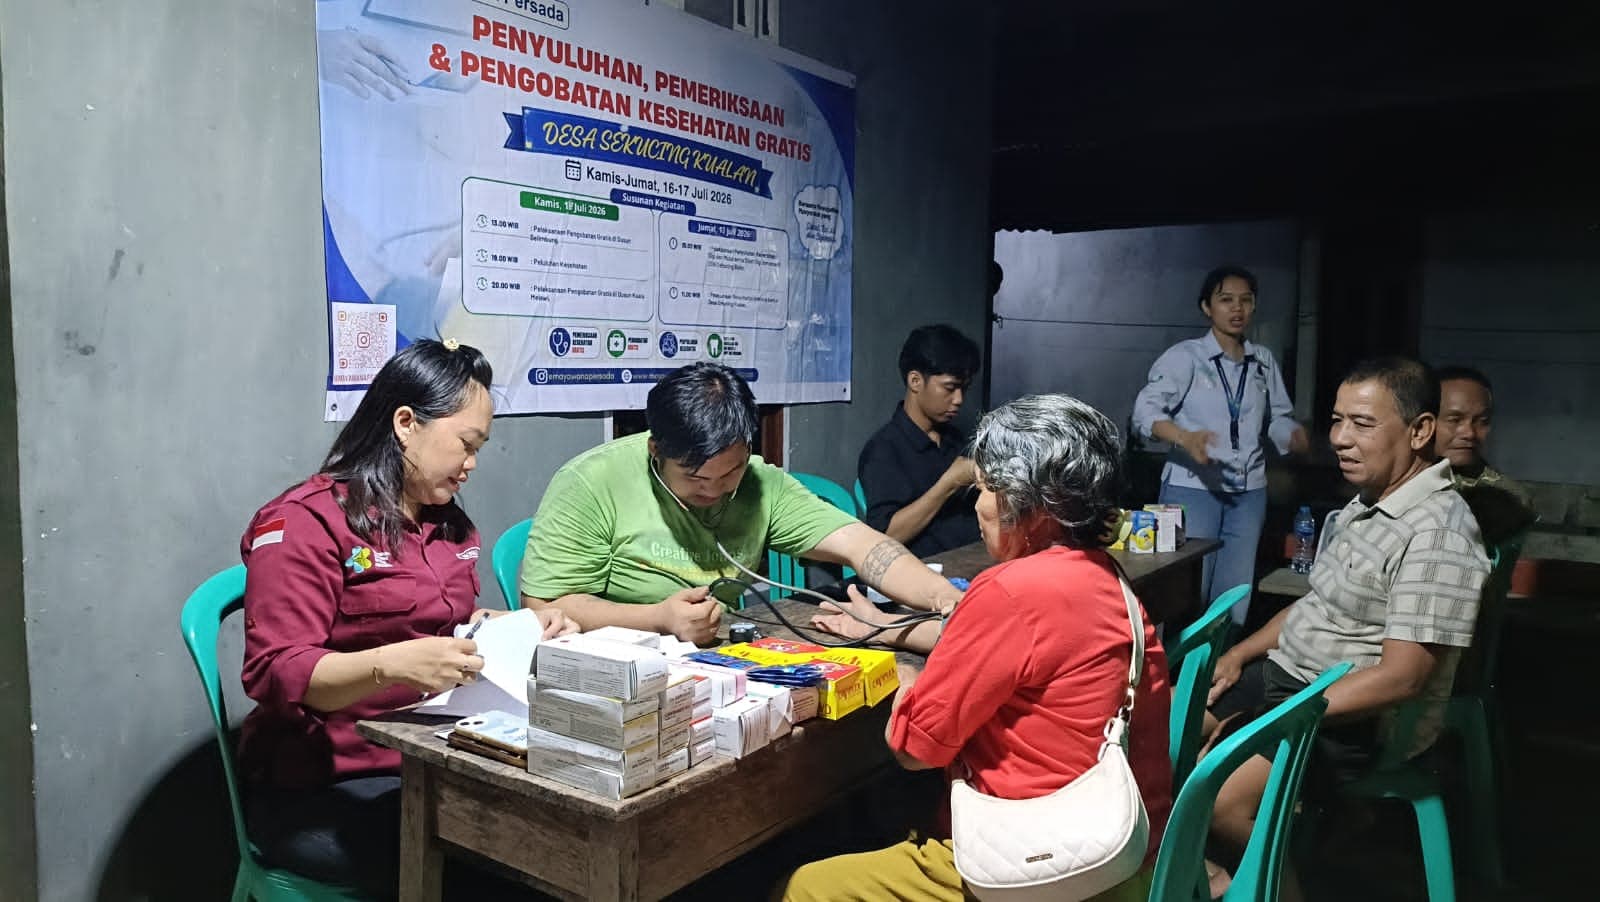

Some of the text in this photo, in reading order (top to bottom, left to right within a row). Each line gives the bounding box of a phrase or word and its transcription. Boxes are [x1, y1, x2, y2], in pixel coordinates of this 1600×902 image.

[504, 0, 564, 22] ersada
[472, 15, 785, 128] PENYULUHAN, PEMERIKSAAN
[429, 43, 812, 163] & PENGOBATAN KESEHATAN GRATIS
[542, 121, 758, 188] DESA SEKUCING KUALAN
[586, 166, 732, 205] Kamis-Jumat, 16-17 Juli 2026
[622, 192, 685, 211] Susunan Kegiatan
[574, 202, 587, 213] Juli
[587, 206, 606, 215] 2026
